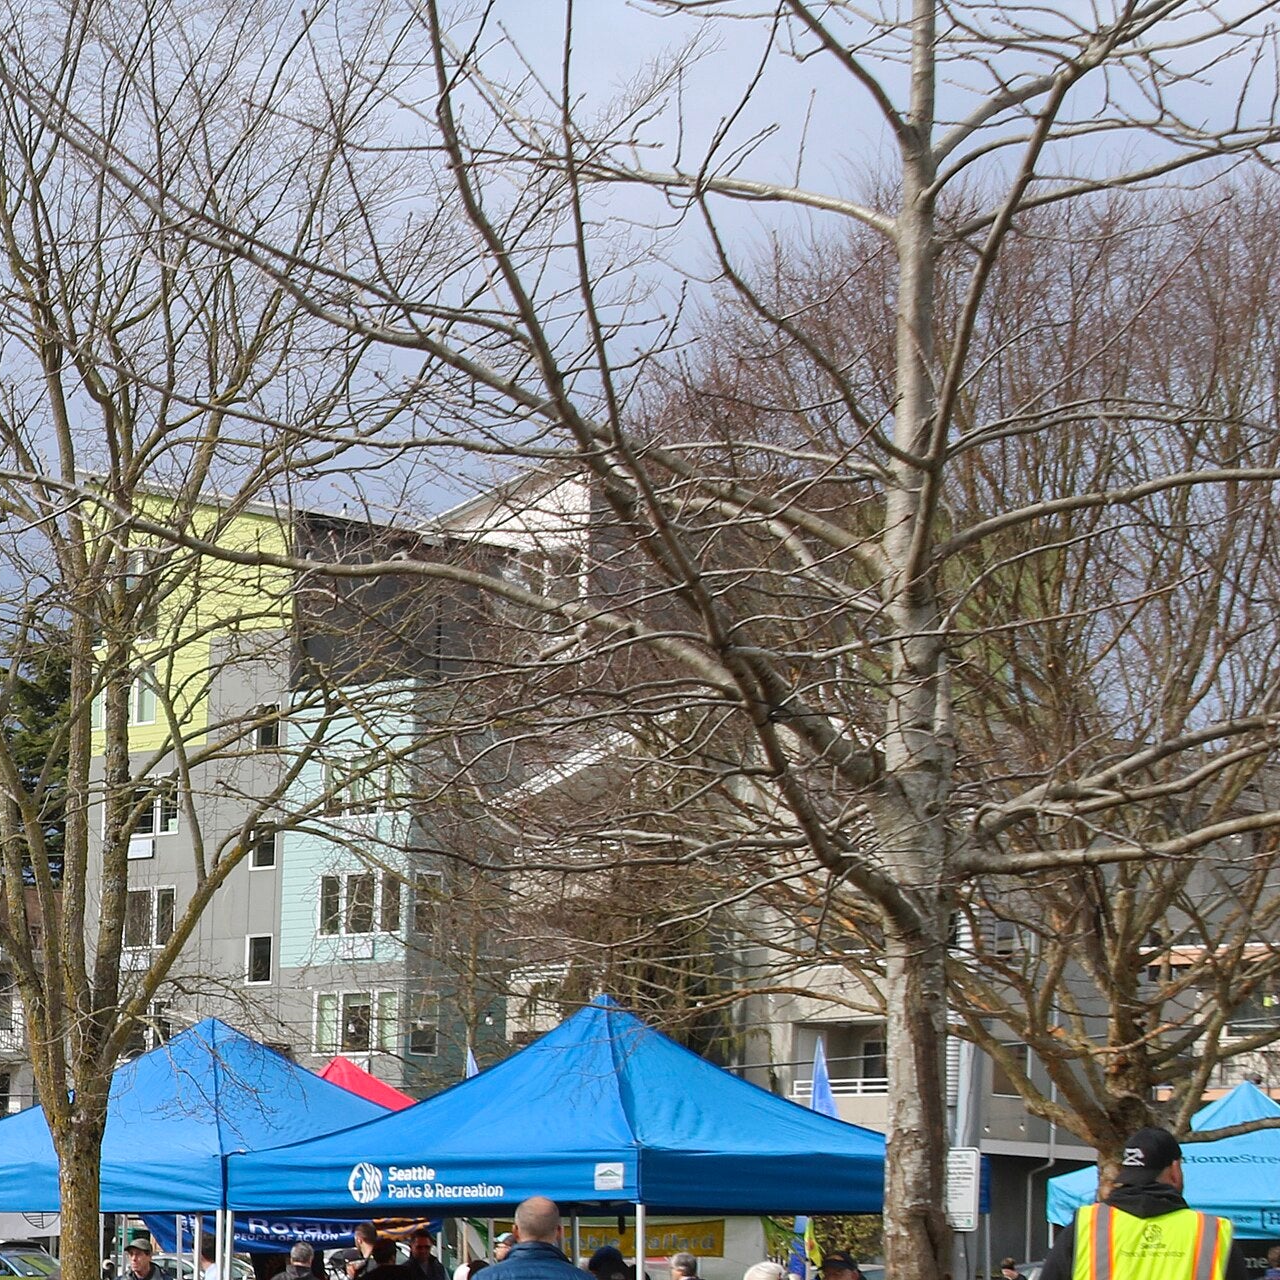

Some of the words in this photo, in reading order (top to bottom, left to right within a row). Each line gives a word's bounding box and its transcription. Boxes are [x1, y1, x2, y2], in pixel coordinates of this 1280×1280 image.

[388, 1166, 435, 1181] Seattle
[388, 1184, 422, 1198] Parks
[424, 1184, 433, 1197] &
[436, 1183, 504, 1198] Recreation
[248, 1217, 356, 1236] Rotary
[234, 1233, 276, 1241] PEOPLE
[278, 1234, 293, 1242] OF
[296, 1232, 339, 1242] ACTION
